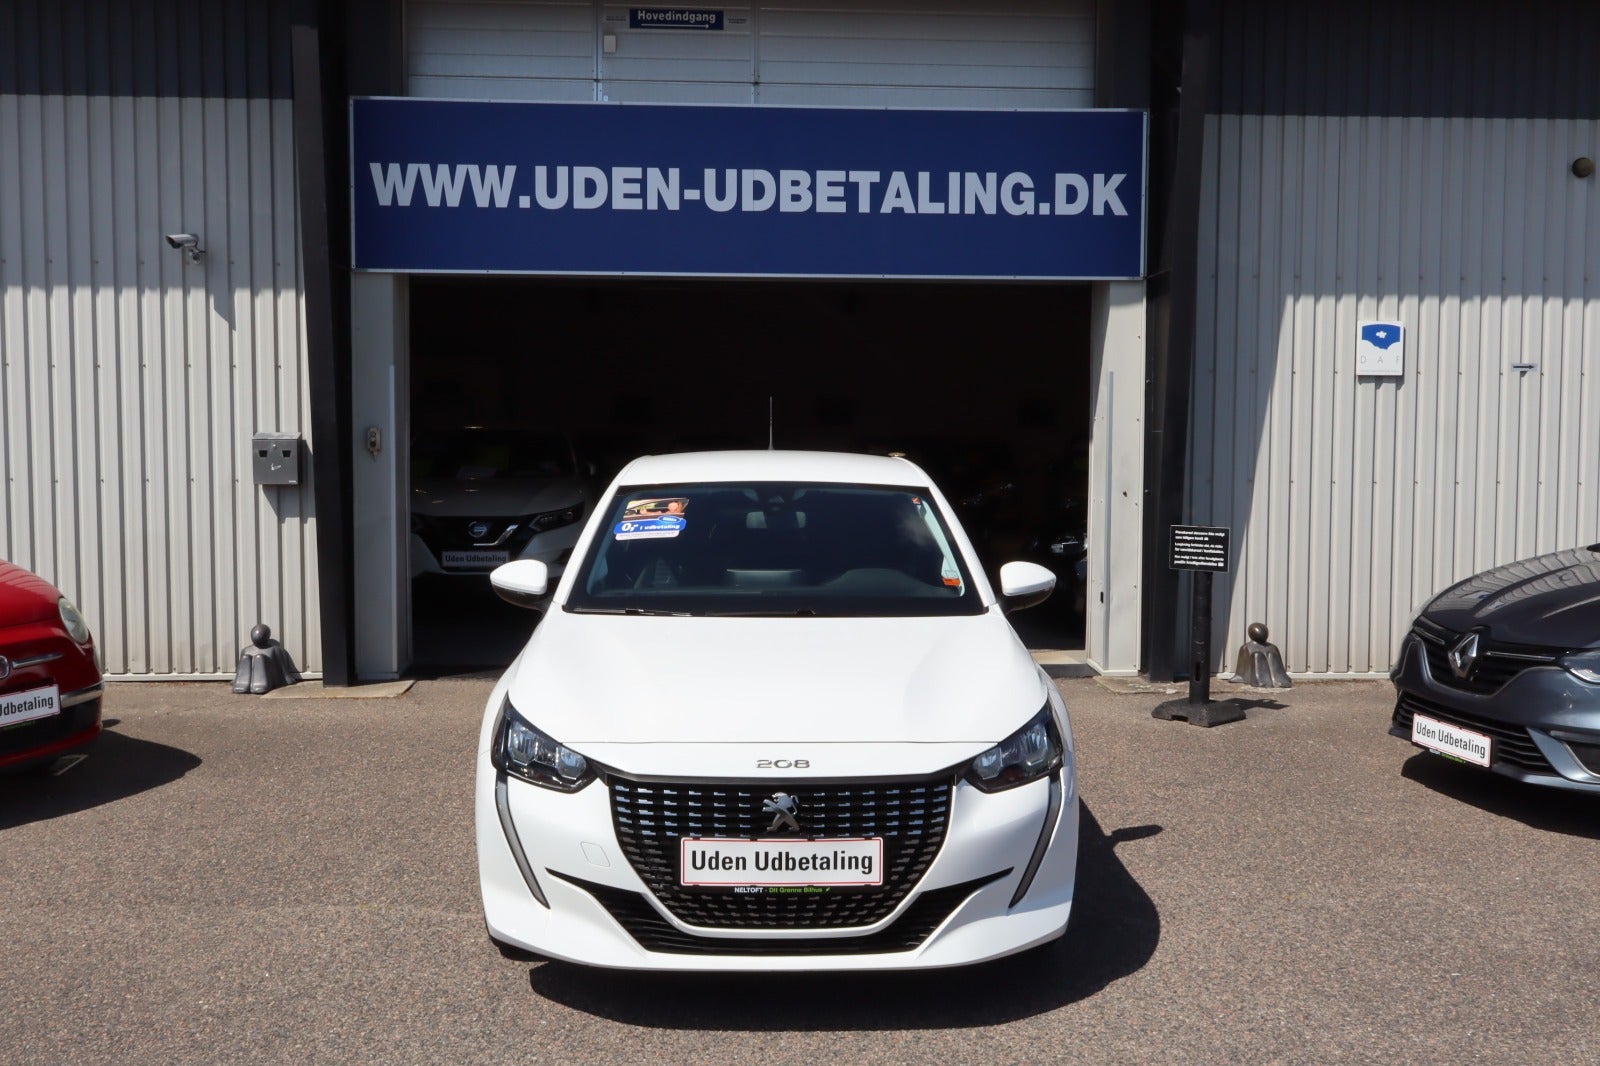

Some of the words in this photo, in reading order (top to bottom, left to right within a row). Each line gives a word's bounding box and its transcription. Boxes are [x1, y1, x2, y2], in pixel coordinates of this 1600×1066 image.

[638, 10, 716, 23] Hovedindgang
[369, 162, 1129, 216] WWW.UDEN-UDBETALING.DK
[1416, 721, 1436, 740] Uden
[1438, 729, 1486, 759] Udbetaling
[757, 759, 810, 769] 208
[691, 850, 747, 871] Uden
[755, 851, 873, 875] Udbetaling
